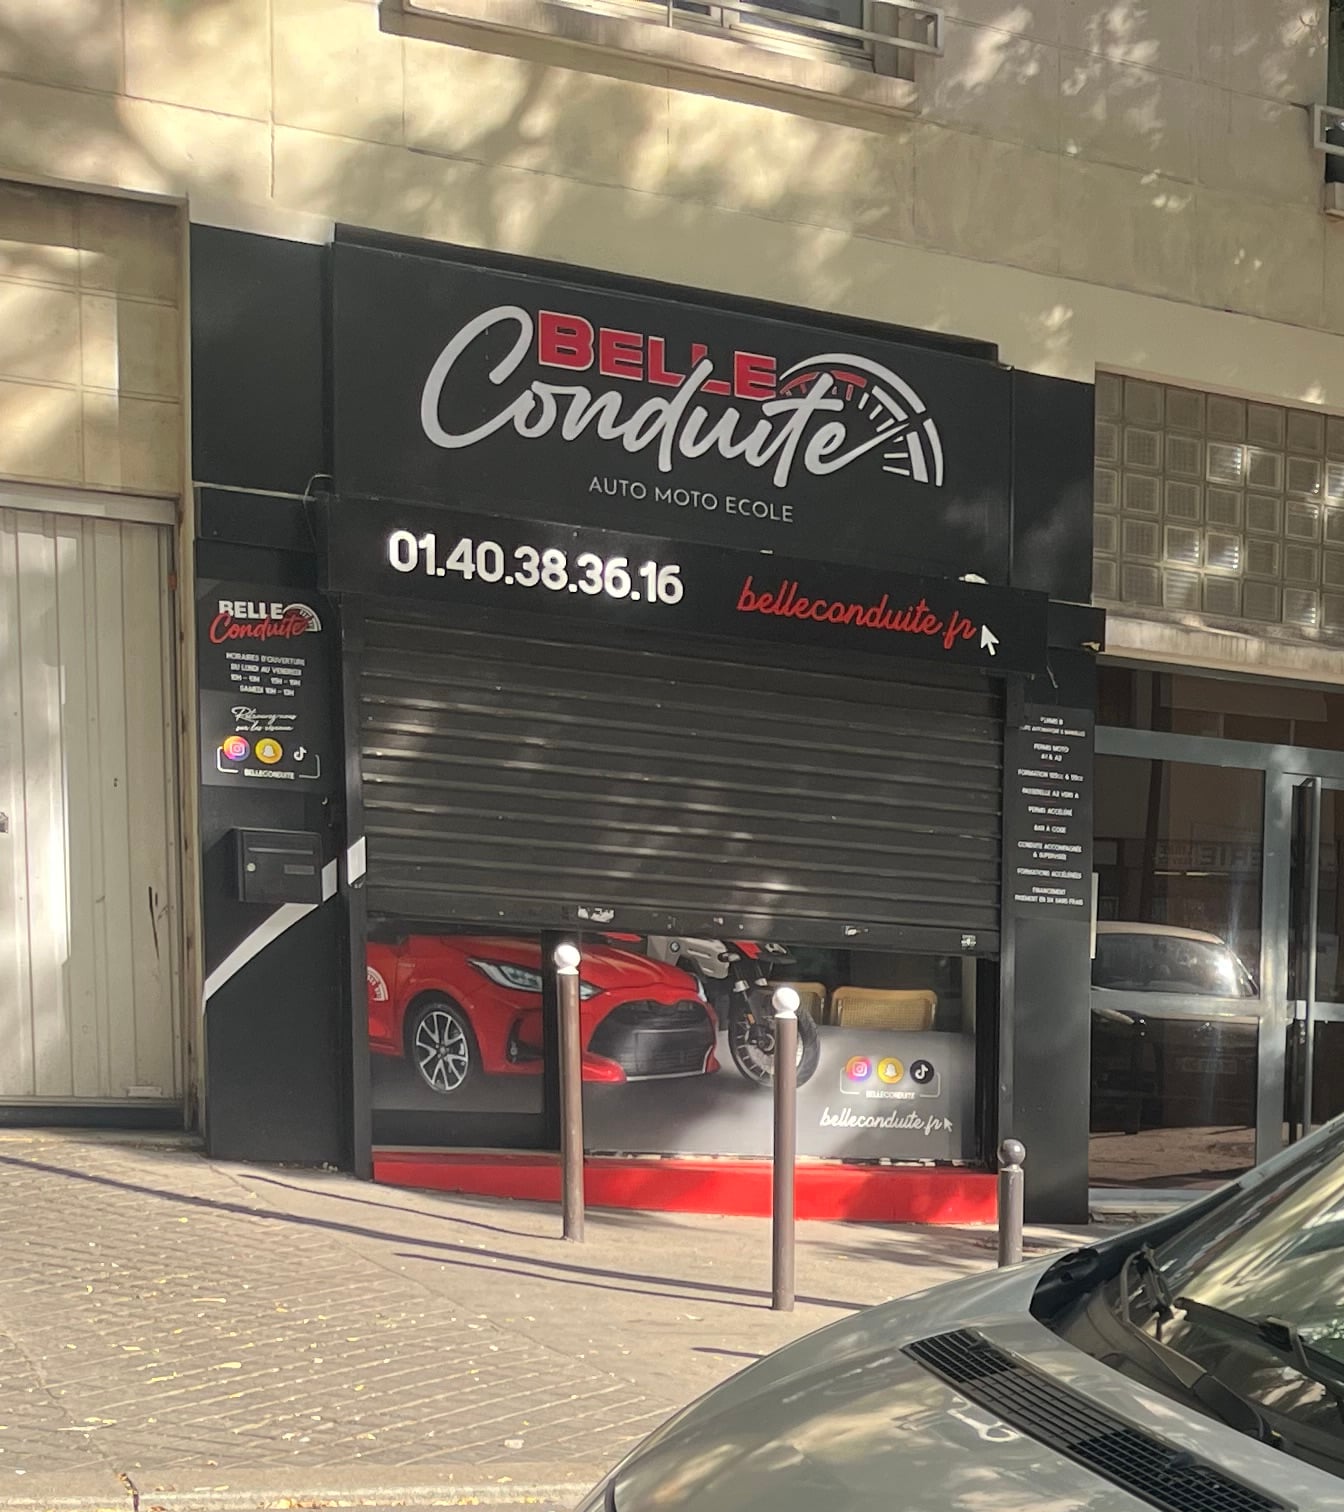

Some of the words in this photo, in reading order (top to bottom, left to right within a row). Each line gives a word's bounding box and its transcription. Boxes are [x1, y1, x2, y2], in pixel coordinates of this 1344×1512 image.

[538, 310, 777, 401] BELLE
[420, 305, 896, 488] Conduite
[588, 475, 648, 501] AUTO
[654, 485, 719, 511] MOTO
[725, 496, 794, 523] ECOLE
[388, 530, 684, 606] 01.40.38.36.16
[209, 612, 311, 644] Conduite
[218, 600, 285, 620] BELLE
[736, 576, 977, 650] belleconduite.fr
[820, 1107, 943, 1136] belleconduite.fr
